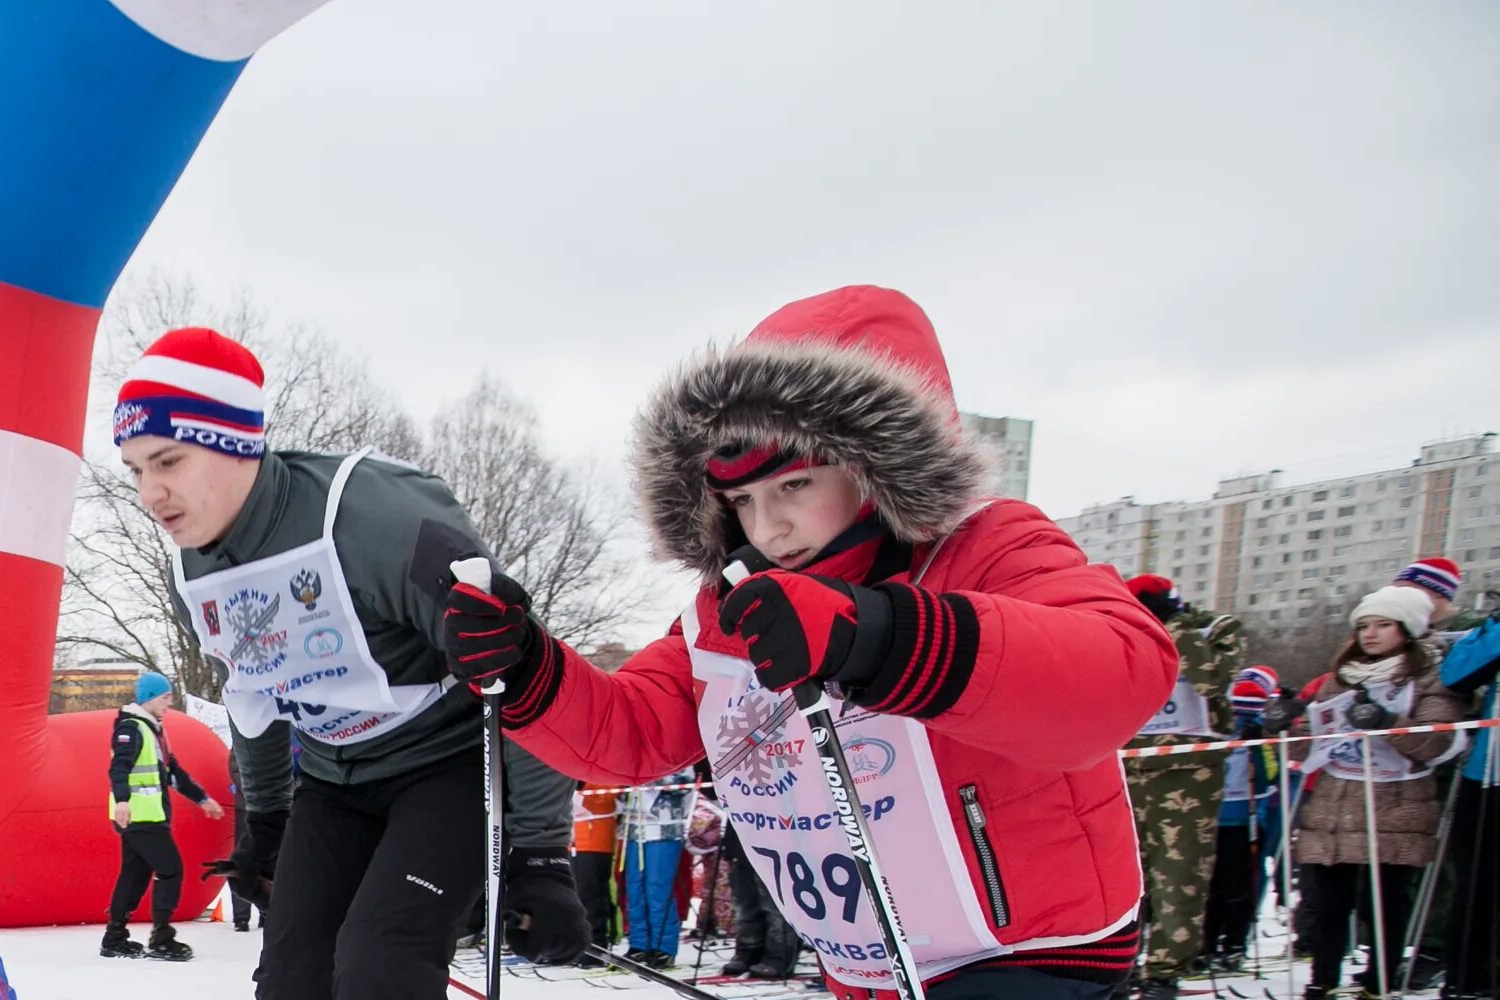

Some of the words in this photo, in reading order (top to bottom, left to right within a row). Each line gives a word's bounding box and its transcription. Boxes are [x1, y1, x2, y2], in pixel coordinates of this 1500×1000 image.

[224, 588, 269, 616] ЛЫЖНЯ
[260, 629, 288, 646] 2017
[237, 651, 288, 676] РОССИИ
[226, 665, 348, 696] тмастер
[764, 739, 806, 758] 2017
[730, 769, 798, 798] РОССИИ
[722, 795, 896, 832] портмасер
[820, 756, 871, 864] NORDWAY
[492, 824, 501, 878] NORDWAY
[751, 846, 862, 923] 789
[881, 876, 908, 943] NORDWAY
[800, 932, 888, 961] осква
